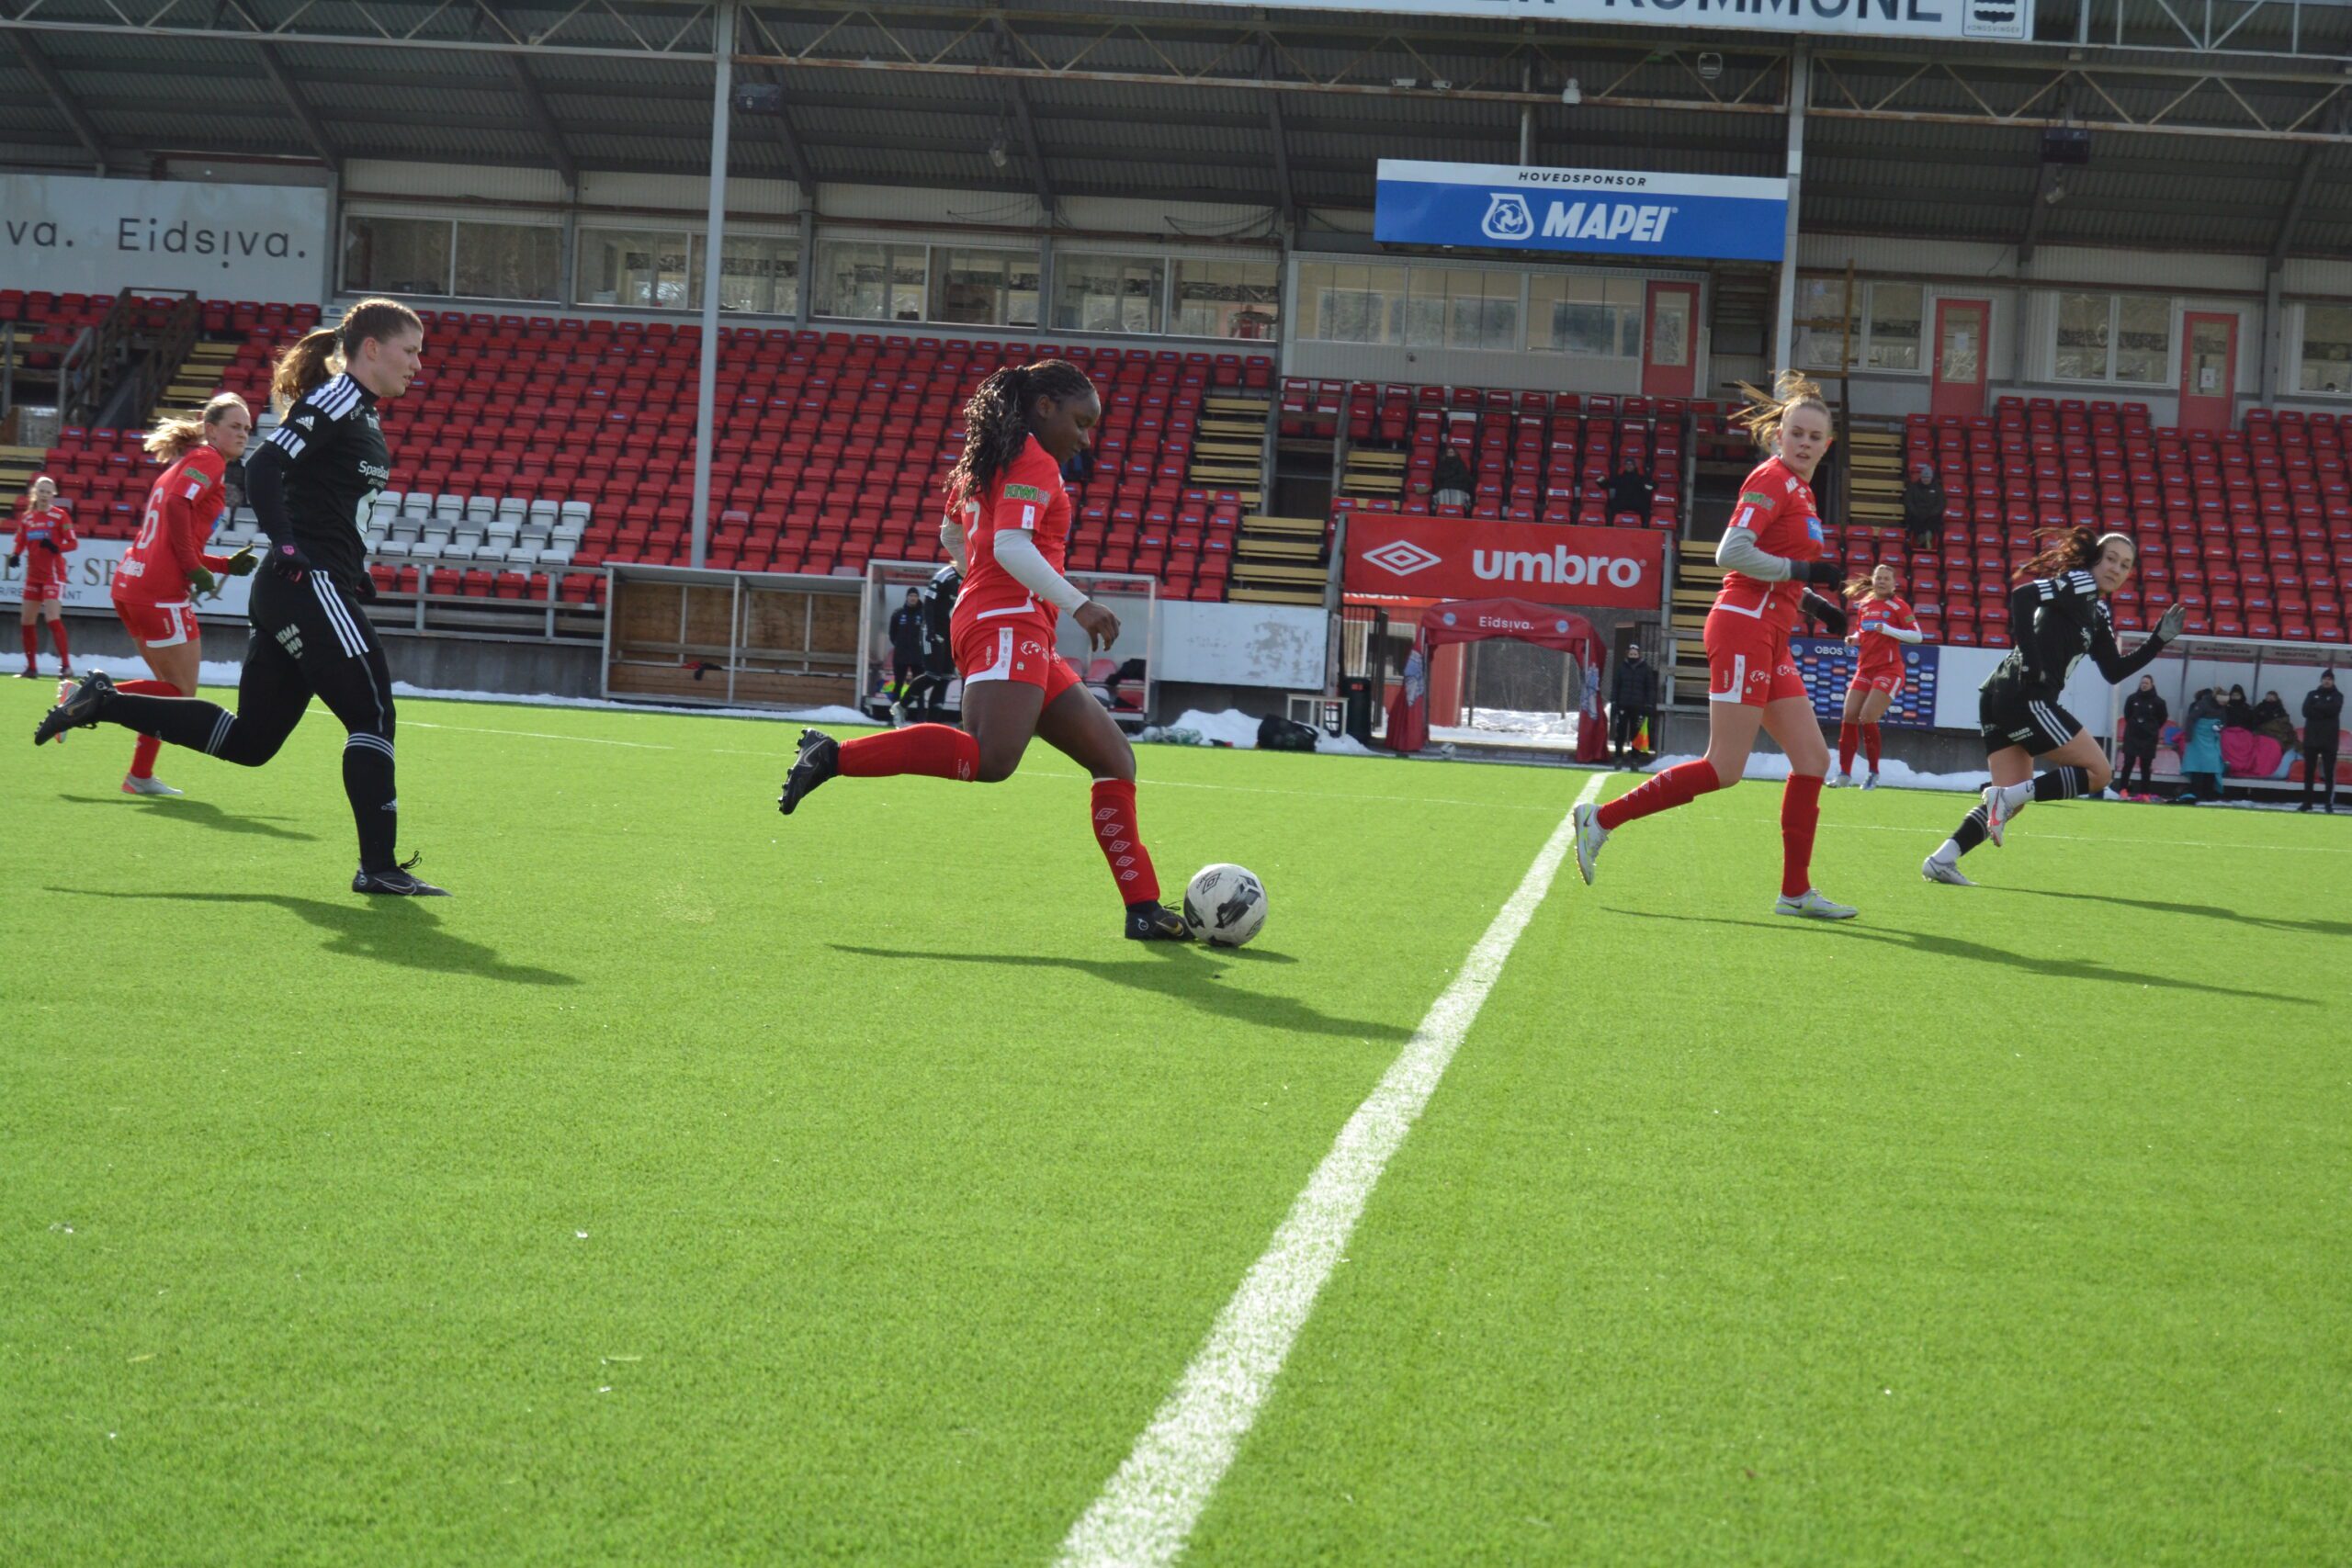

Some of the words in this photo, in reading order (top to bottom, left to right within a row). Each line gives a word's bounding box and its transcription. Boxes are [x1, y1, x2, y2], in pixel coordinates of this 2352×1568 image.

[1518, 172, 1647, 186] HOVEDSPONSOR
[1540, 200, 1672, 243] MAPEI
[136, 487, 164, 549] 6
[1472, 544, 1642, 589] umbro
[1814, 645, 1844, 656] OBOS
